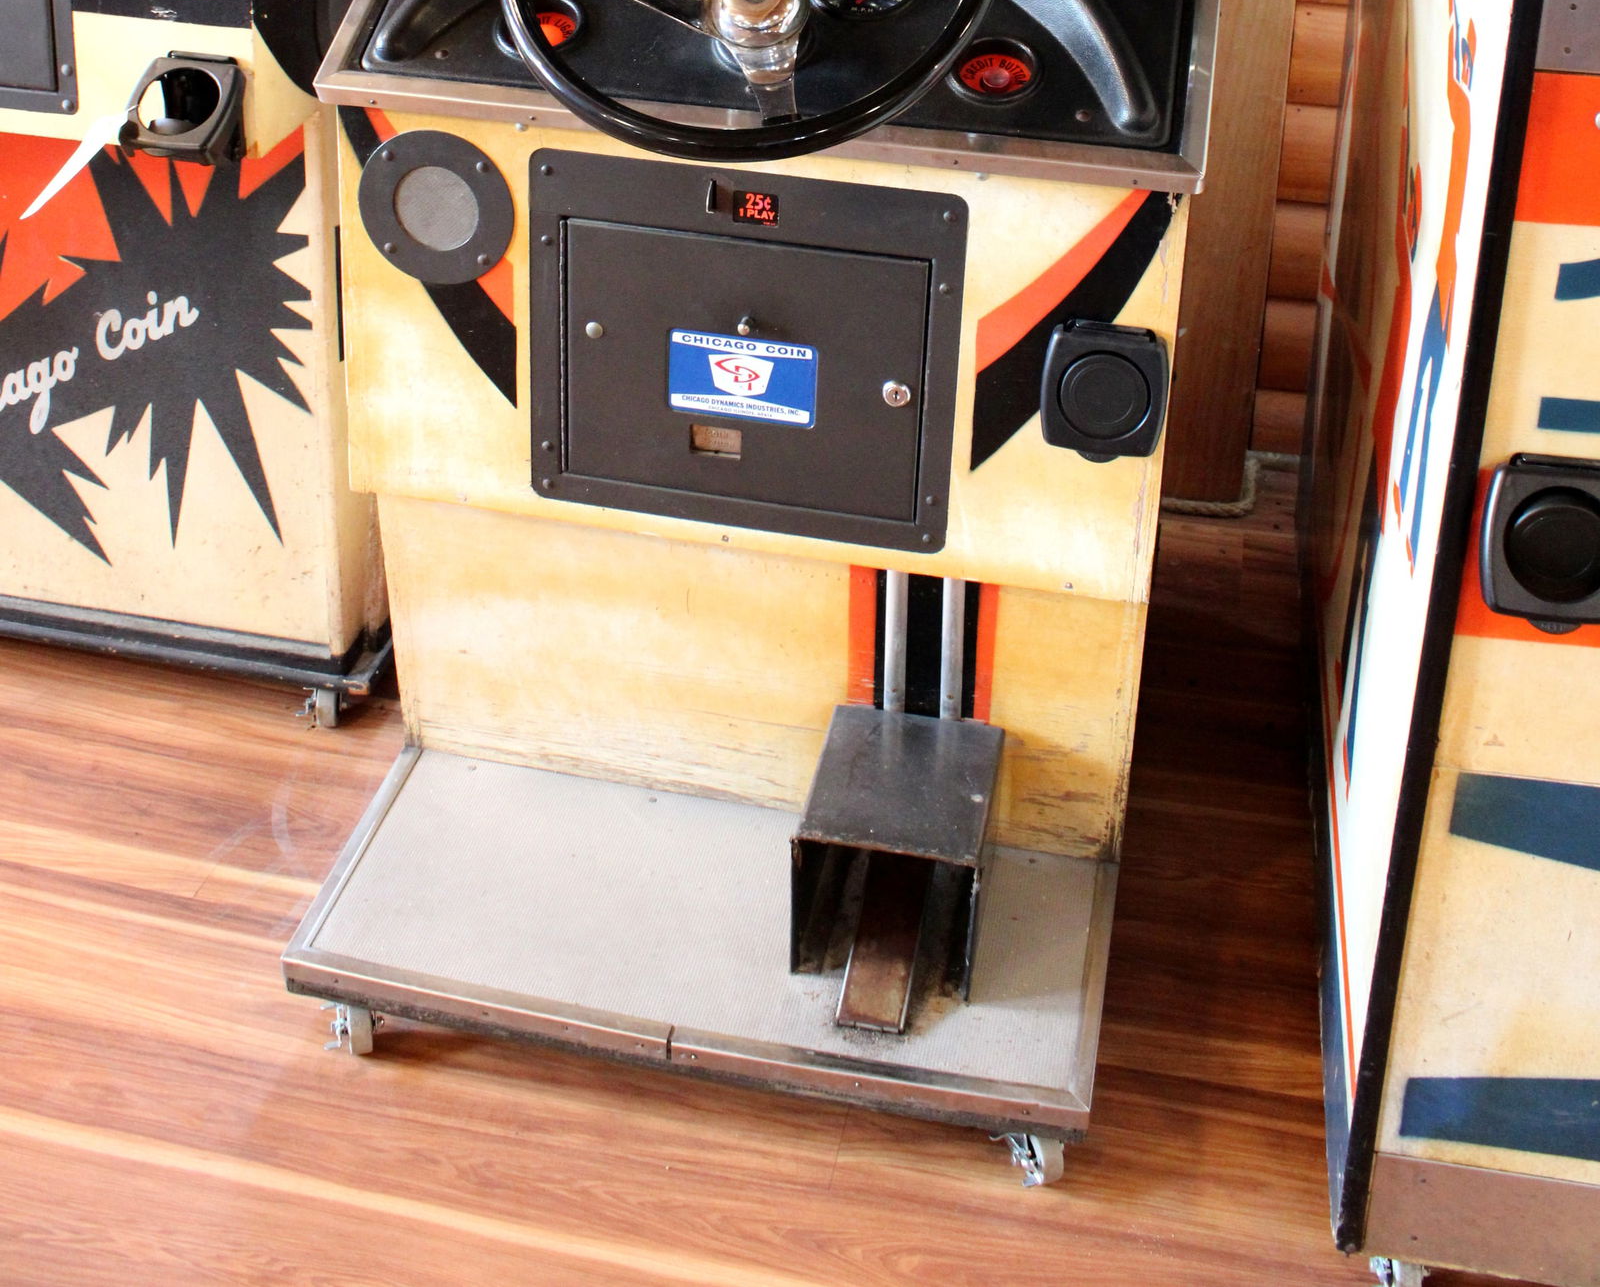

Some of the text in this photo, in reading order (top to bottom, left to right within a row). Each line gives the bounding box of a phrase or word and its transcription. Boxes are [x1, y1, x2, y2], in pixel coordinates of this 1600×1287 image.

[963, 58, 995, 80] CREDIT
[745, 193, 772, 211] 25¢
[739, 207, 776, 221] 1 PLAY
[95, 290, 200, 361] Coin
[682, 334, 807, 358] CHICAGO COIN
[682, 395, 709, 404] CHICAGO
[711, 398, 745, 410] DYNAMICS
